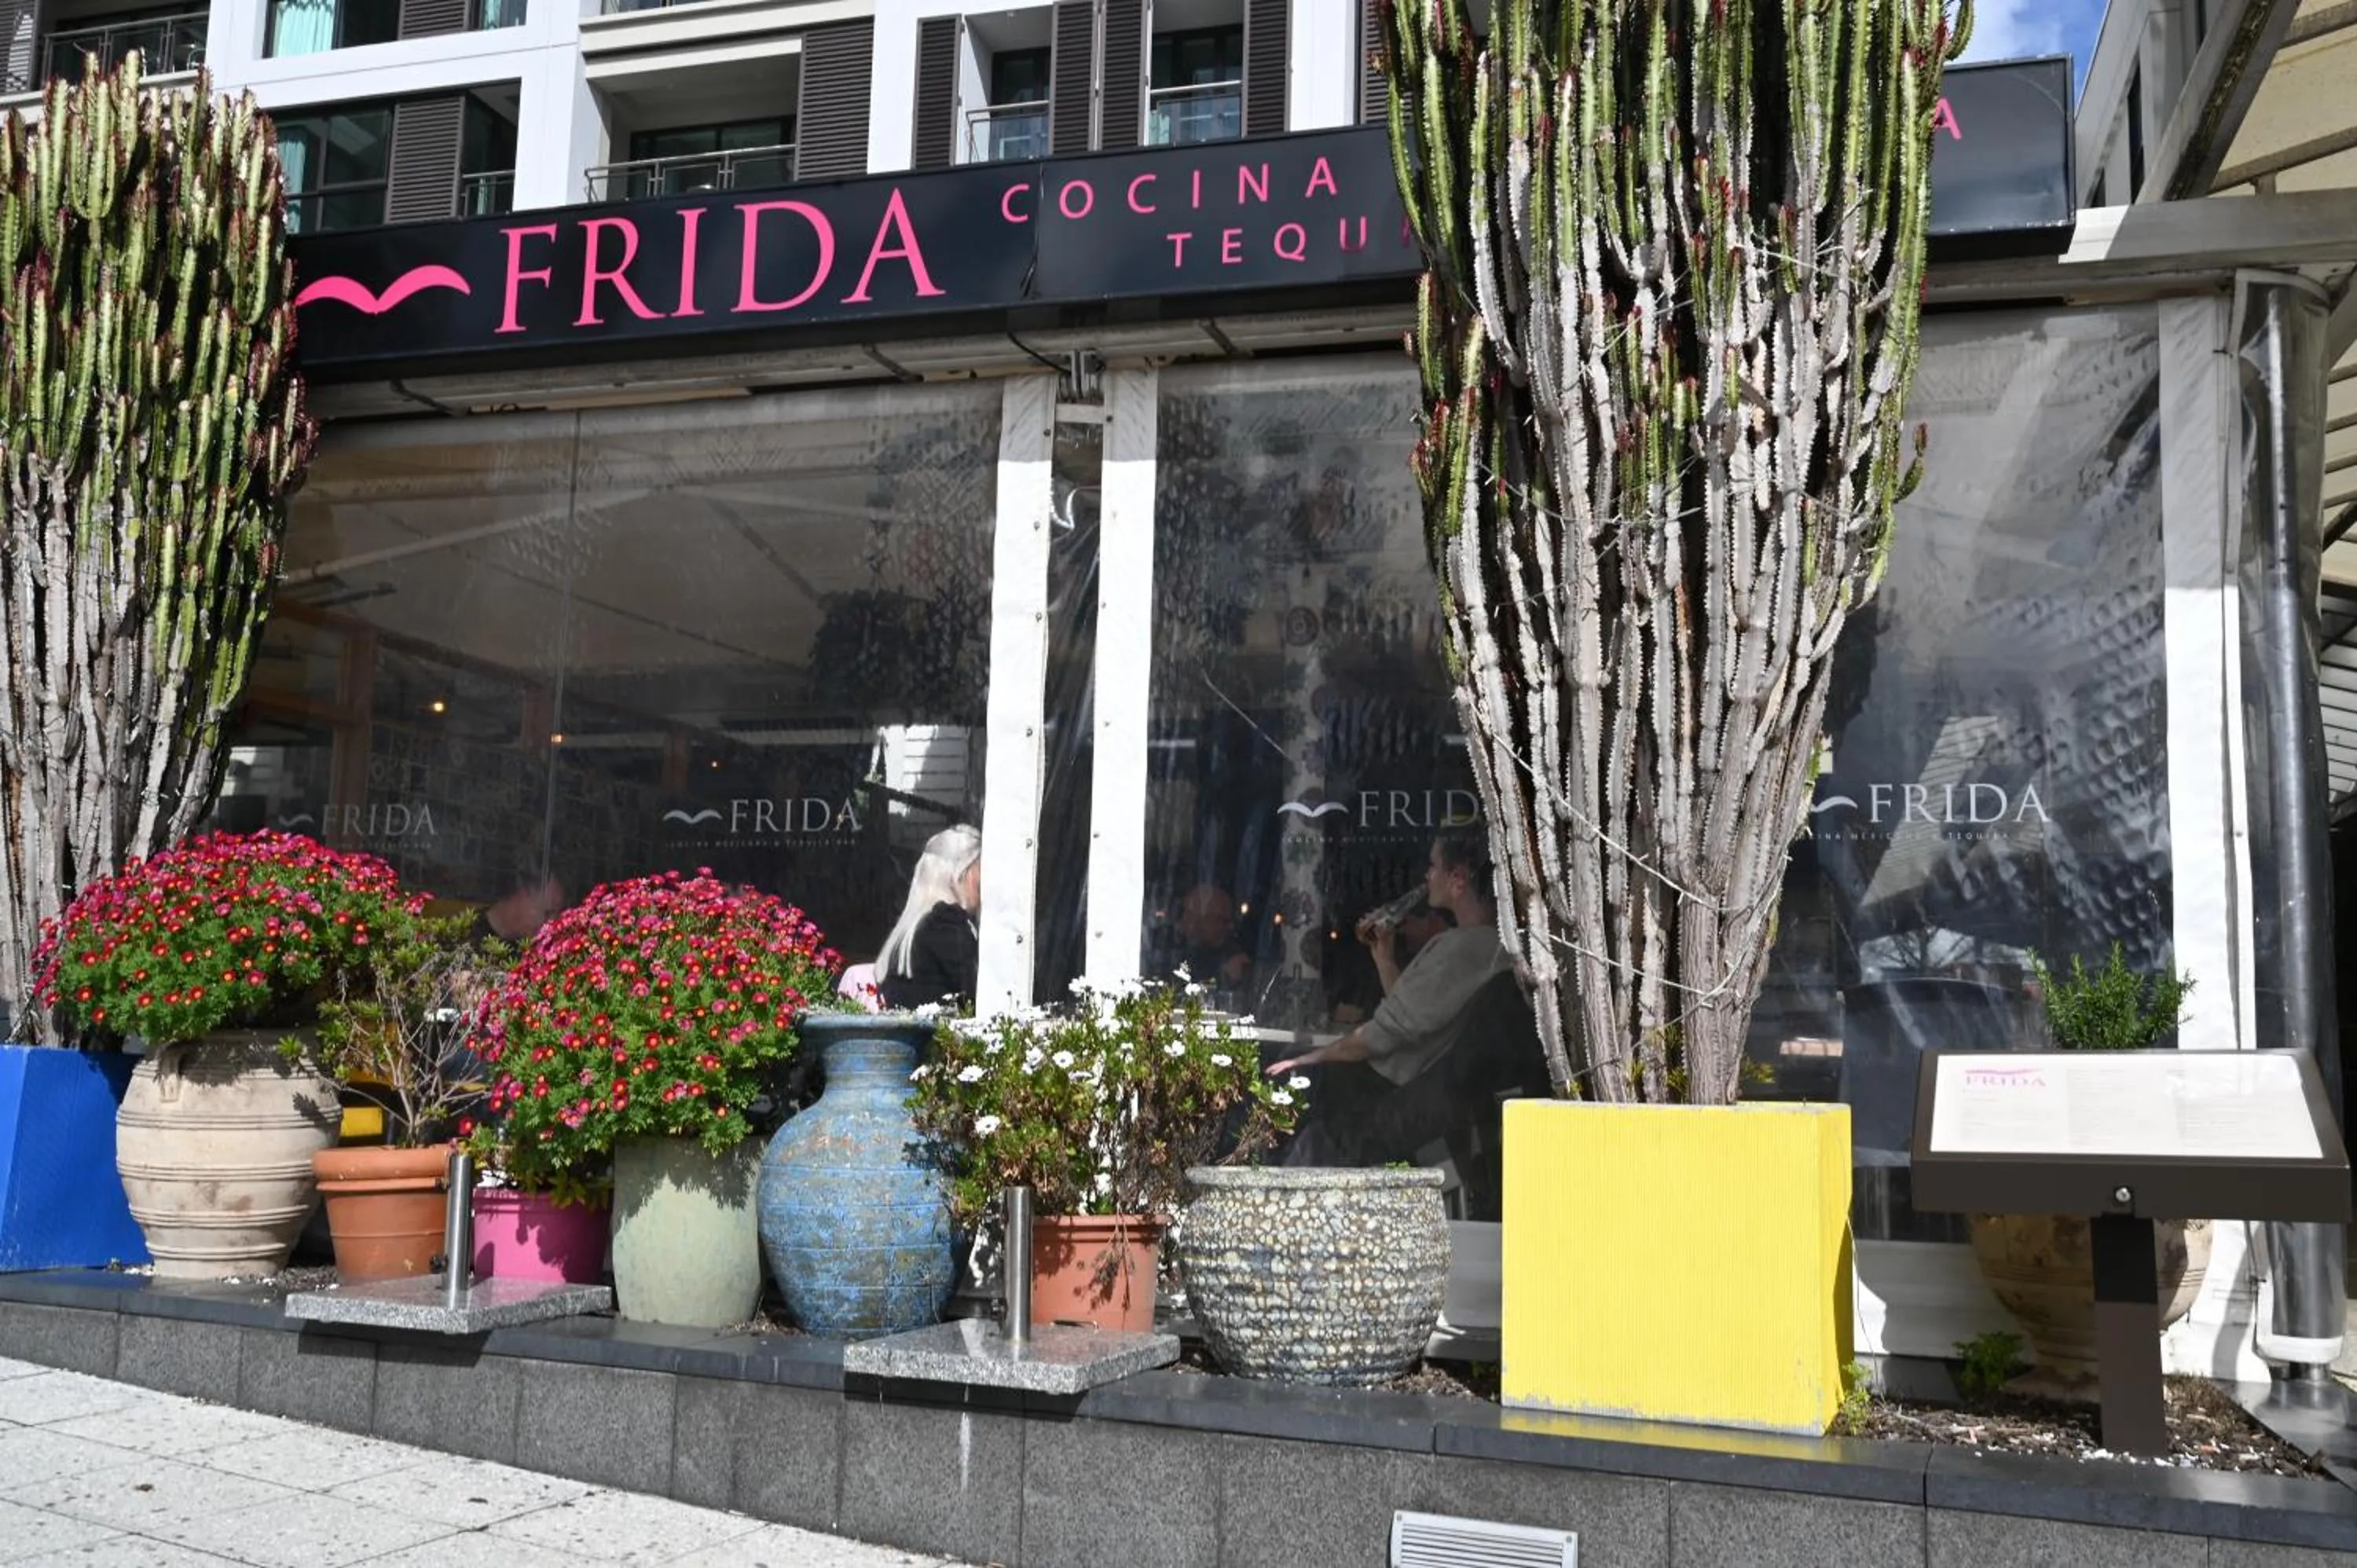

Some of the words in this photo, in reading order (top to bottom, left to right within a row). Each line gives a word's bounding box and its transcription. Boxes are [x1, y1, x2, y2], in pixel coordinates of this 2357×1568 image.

[1001, 156, 1338, 223] COCINA
[1167, 213, 1412, 267] TEQUI
[494, 188, 946, 334] FRIDA
[321, 803, 439, 837] FRIDA
[729, 797, 863, 833] FRIDA
[1357, 788, 1481, 828] FRID
[1868, 783, 2051, 823] FRIDA
